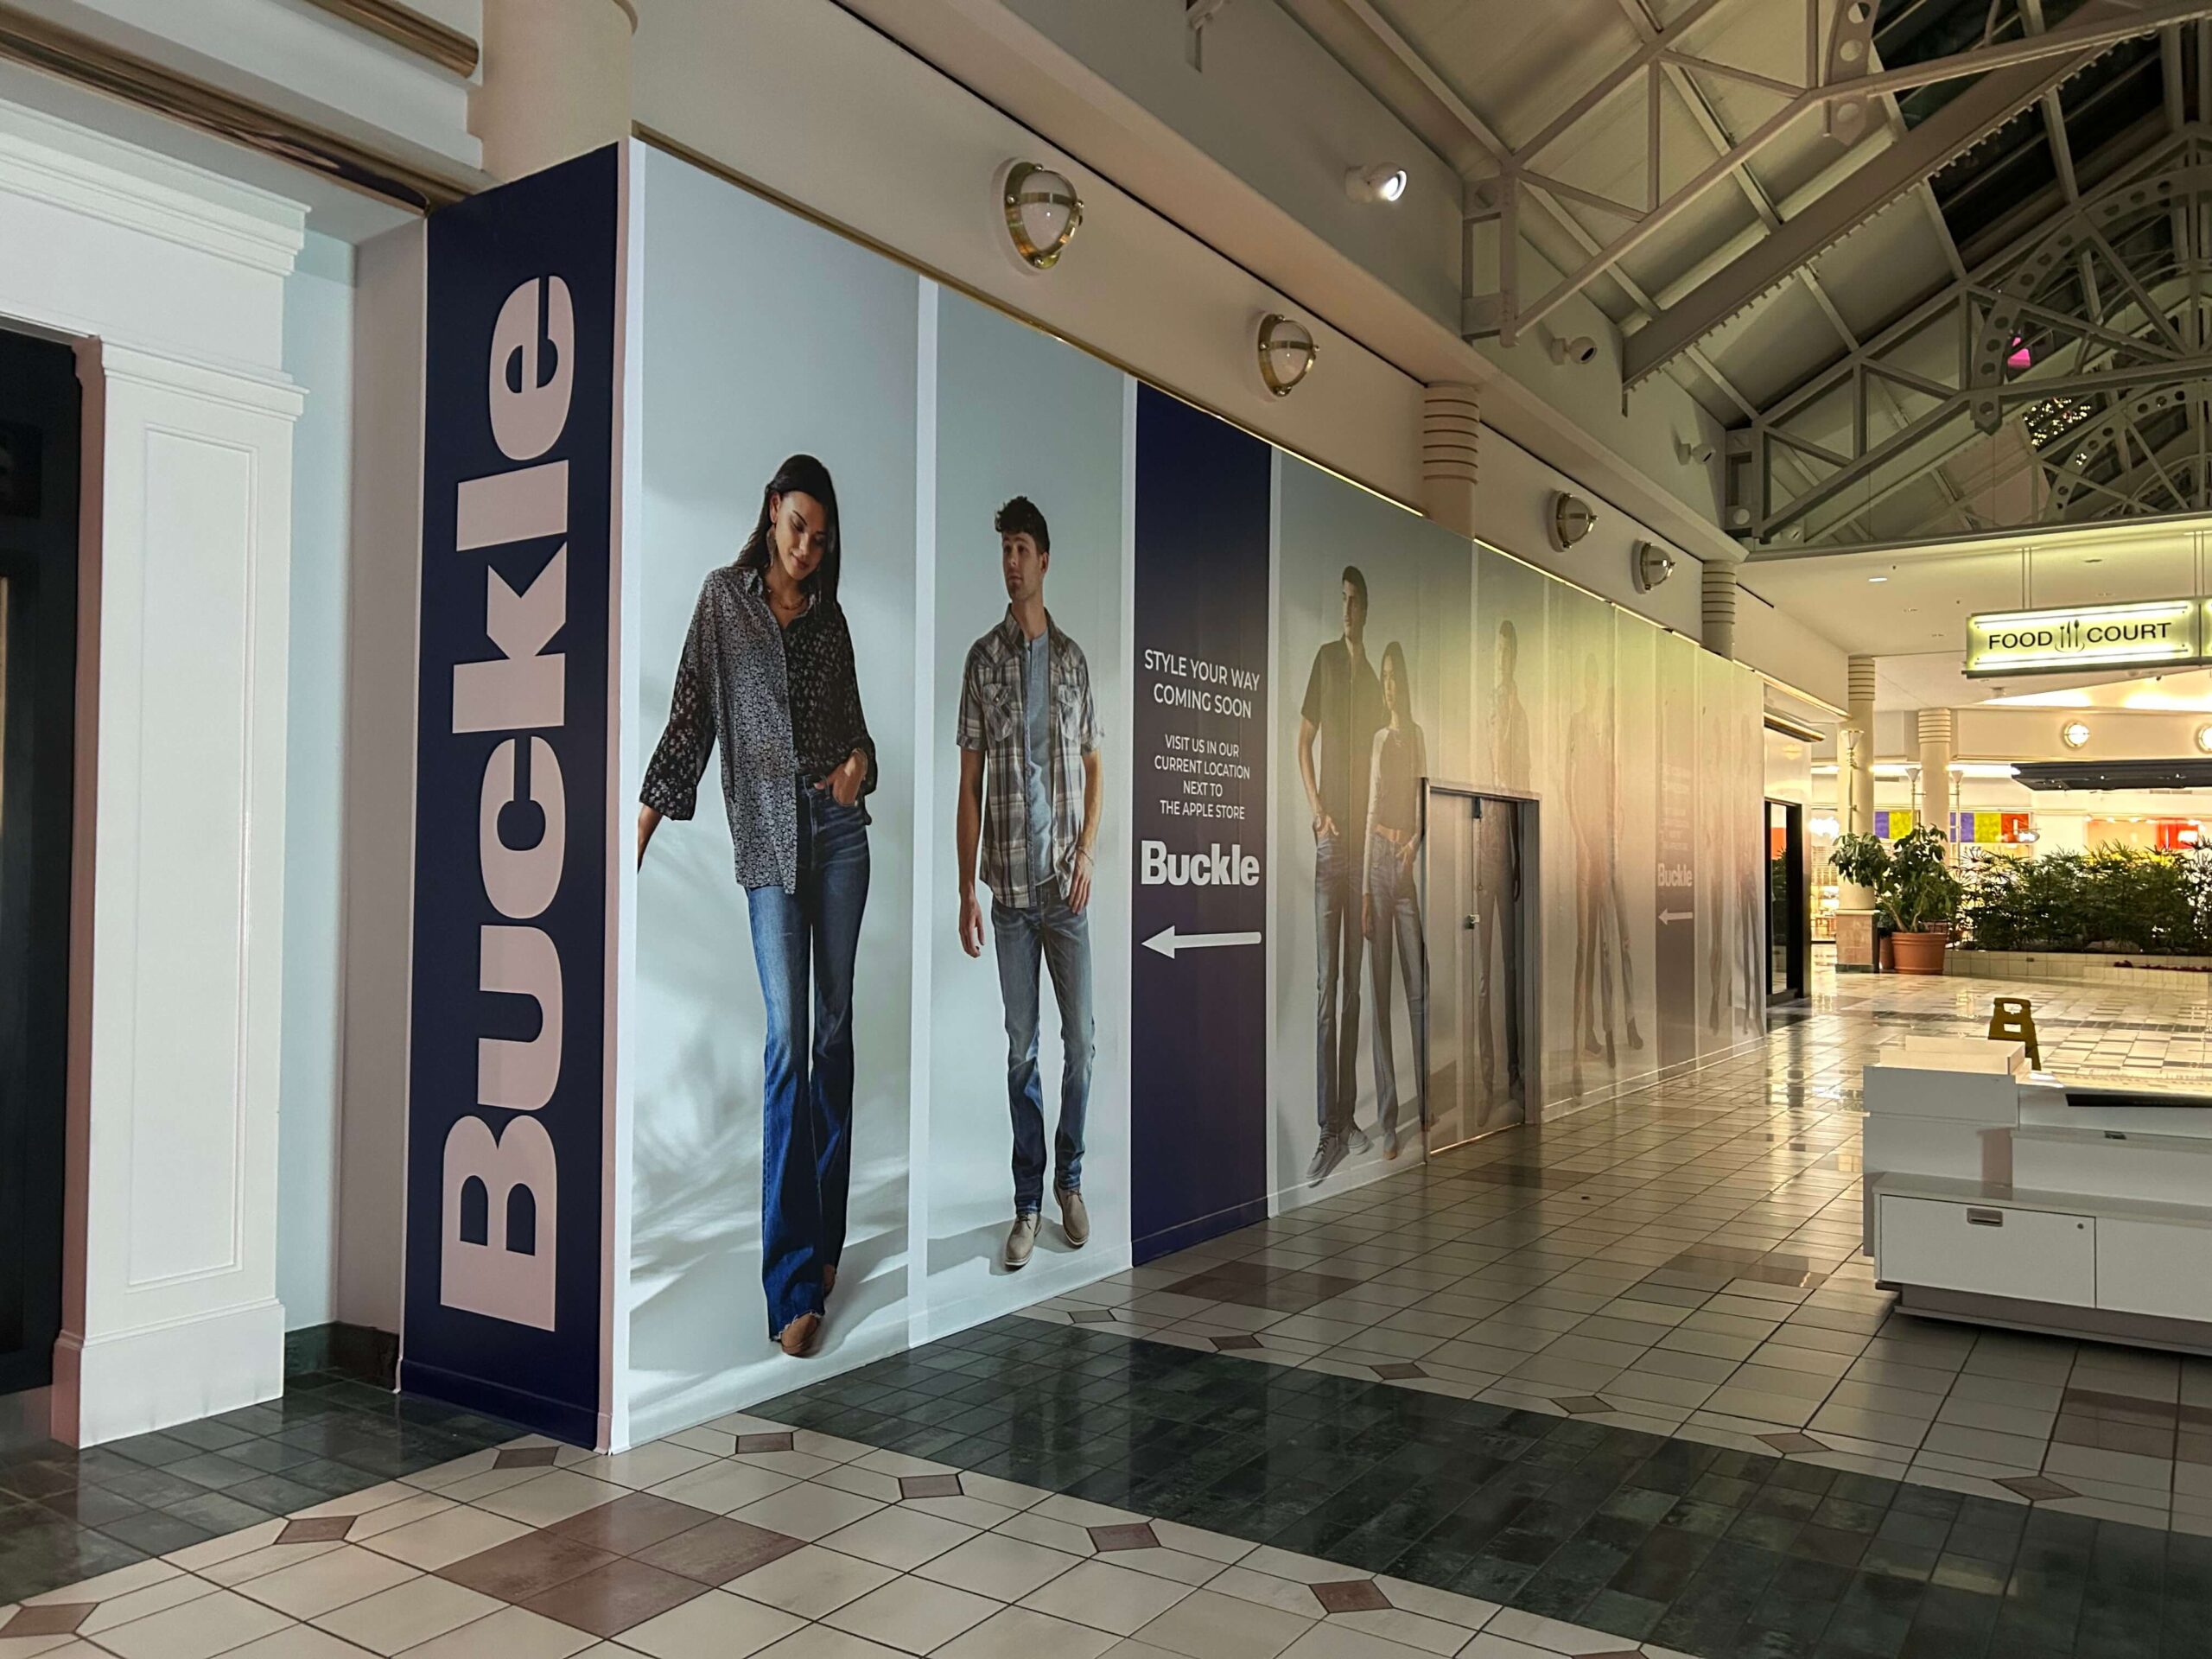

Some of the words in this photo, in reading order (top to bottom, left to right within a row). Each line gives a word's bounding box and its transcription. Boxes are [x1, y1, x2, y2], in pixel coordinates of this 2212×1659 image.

[1988, 631, 2053, 649] FOOD
[2087, 622, 2171, 643] COURT
[1144, 649, 1187, 677] STYLE
[1191, 658, 1228, 685] YOUR
[1230, 668, 1260, 691] WAY
[1154, 683, 1211, 711] COMING
[1214, 695, 1251, 718] SOON
[1165, 734, 1190, 751] VISIT
[1192, 738, 1205, 753] US
[1207, 741, 1217, 755] IN
[1219, 742, 1239, 758] OUR
[1154, 755, 1202, 774] CURRENT
[1204, 761, 1250, 779] LOCATION
[1183, 780, 1208, 796] NEXT
[1210, 783, 1223, 797] TO
[441, 275, 575, 1332] Buckle
[1160, 800, 1180, 815] THE
[1182, 802, 1213, 817] APPLE
[1216, 804, 1245, 819] STORE
[1141, 839, 1261, 887] Buckle
[1657, 863, 1694, 887] Buckle
